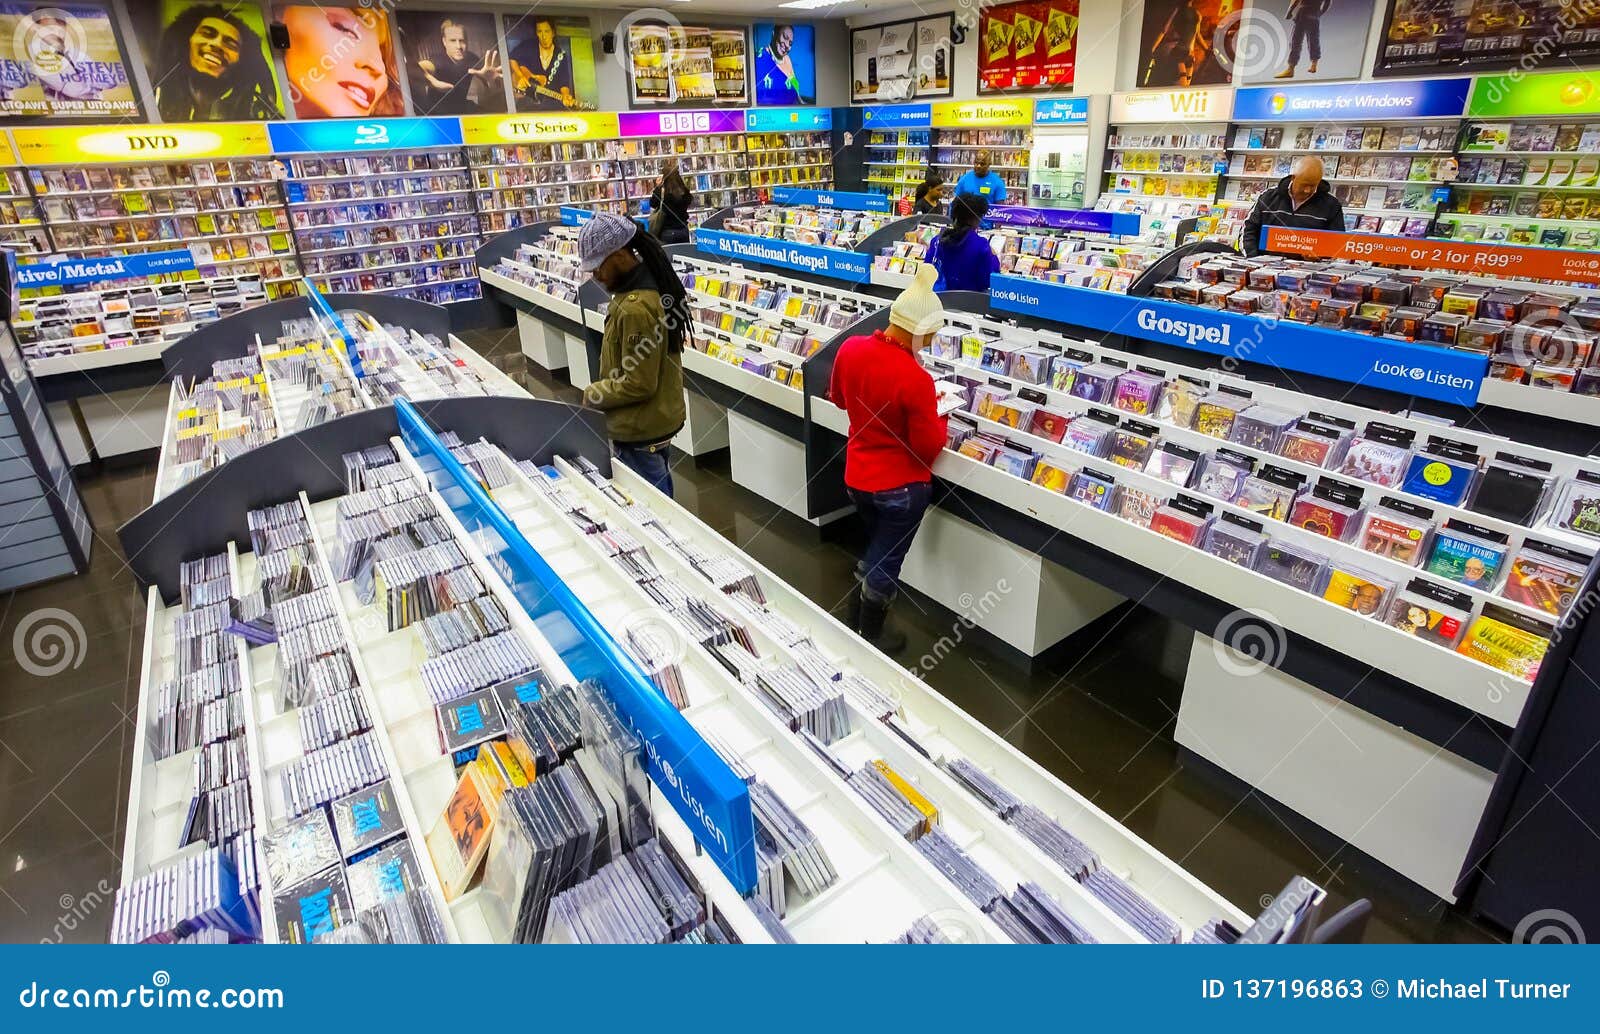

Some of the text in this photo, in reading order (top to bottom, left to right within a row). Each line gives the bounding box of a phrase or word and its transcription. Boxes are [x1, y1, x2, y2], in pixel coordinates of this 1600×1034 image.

[77, 61, 124, 74] STEVE
[60, 72, 127, 84] HOFMEYR
[51, 100, 86, 111] SUPER
[1170, 91, 1208, 113] Wii
[1292, 94, 1414, 109] Games for Windows
[952, 107, 1024, 118] New Releases
[510, 122, 578, 134] TV Series
[661, 113, 709, 131] BBC
[127, 136, 178, 150] DVD
[818, 195, 834, 205] Kids
[719, 238, 732, 252] SA
[1385, 244, 1407, 254] each
[1410, 251, 1426, 260] or
[1431, 249, 1441, 262] 2
[1445, 250, 1469, 264] for
[1562, 257, 1588, 268] Look
[18, 260, 125, 284] tive/Metal
[991, 287, 1039, 305] Look Listen
[1416, 301, 1437, 309] TRIED
[1137, 308, 1231, 347] Gospel
[1373, 359, 1409, 379] Look
[1426, 369, 1475, 390] Listen
[677, 776, 729, 854] Listen
